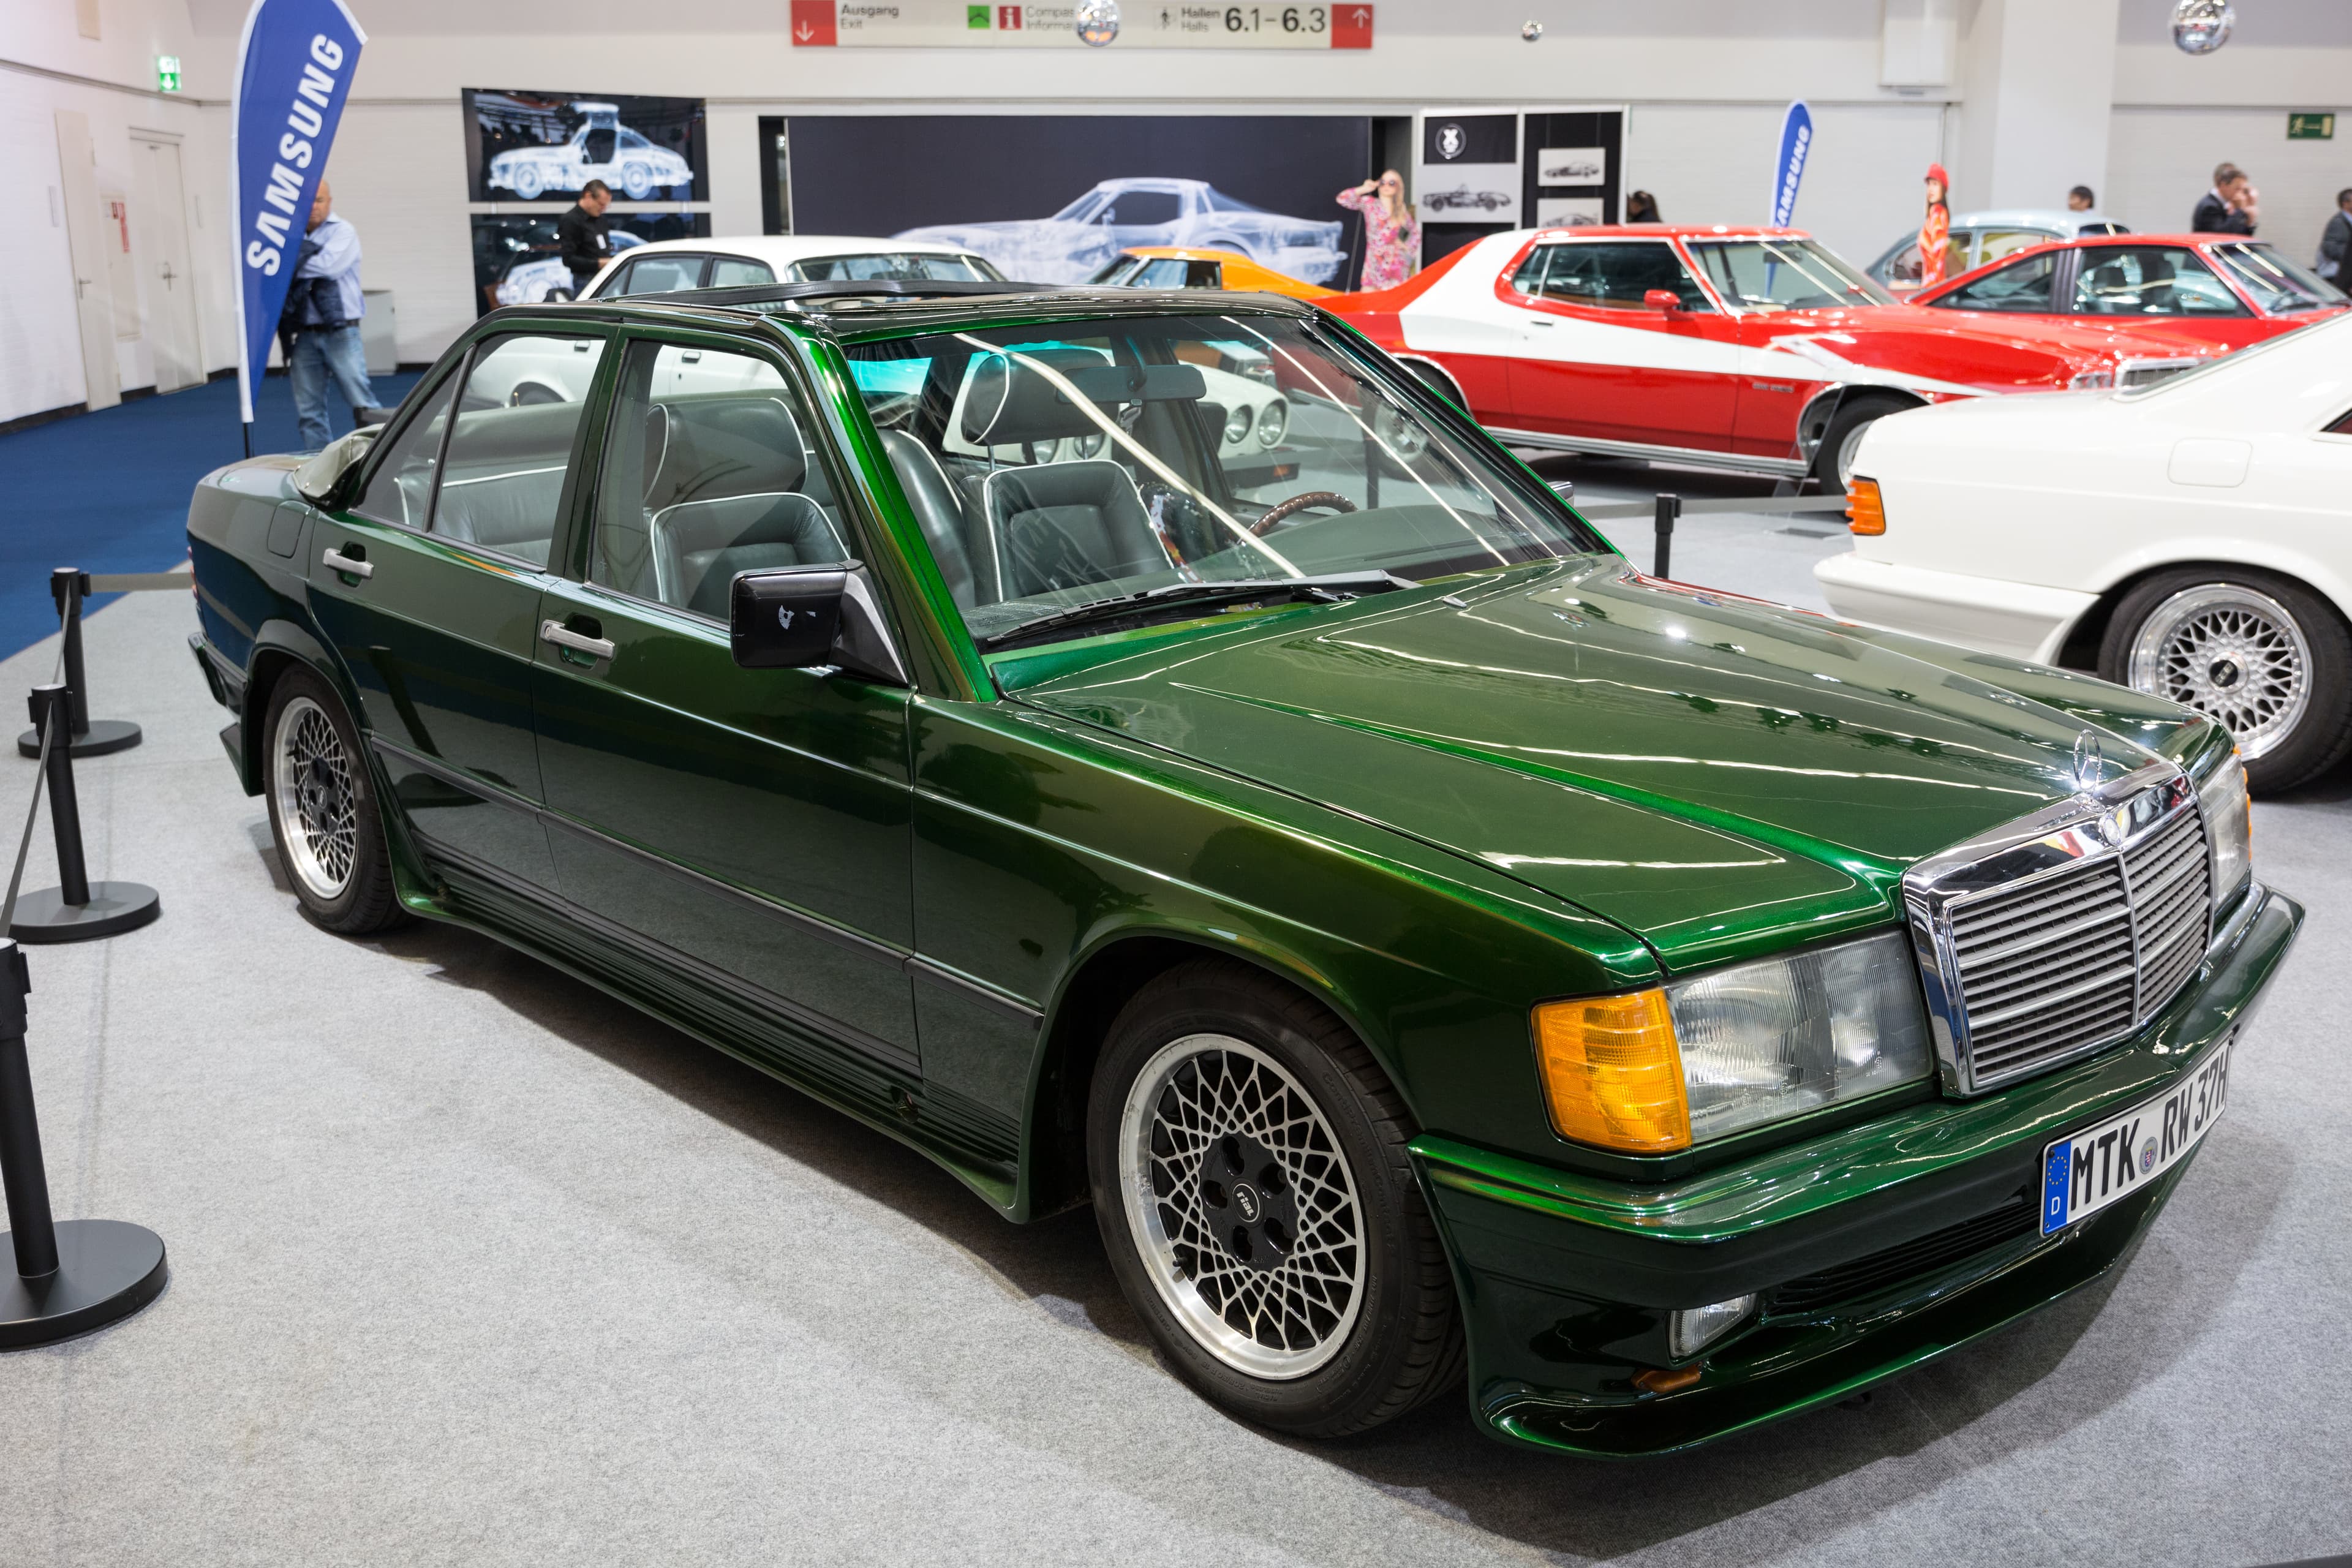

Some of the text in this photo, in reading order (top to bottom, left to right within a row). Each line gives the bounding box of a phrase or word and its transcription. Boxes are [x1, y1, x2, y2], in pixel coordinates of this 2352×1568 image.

[841, 4, 899, 19] Ausgang
[1026, 5, 1076, 18] Compas
[1181, 7, 1220, 18] Hallen
[841, 19, 862, 30] Exit
[1181, 22, 1209, 32] Halls
[246, 33, 344, 277] SAMSUNG
[2070, 1044, 2230, 1212] MTK RW 37H
[2051, 1196, 2061, 1216] D
